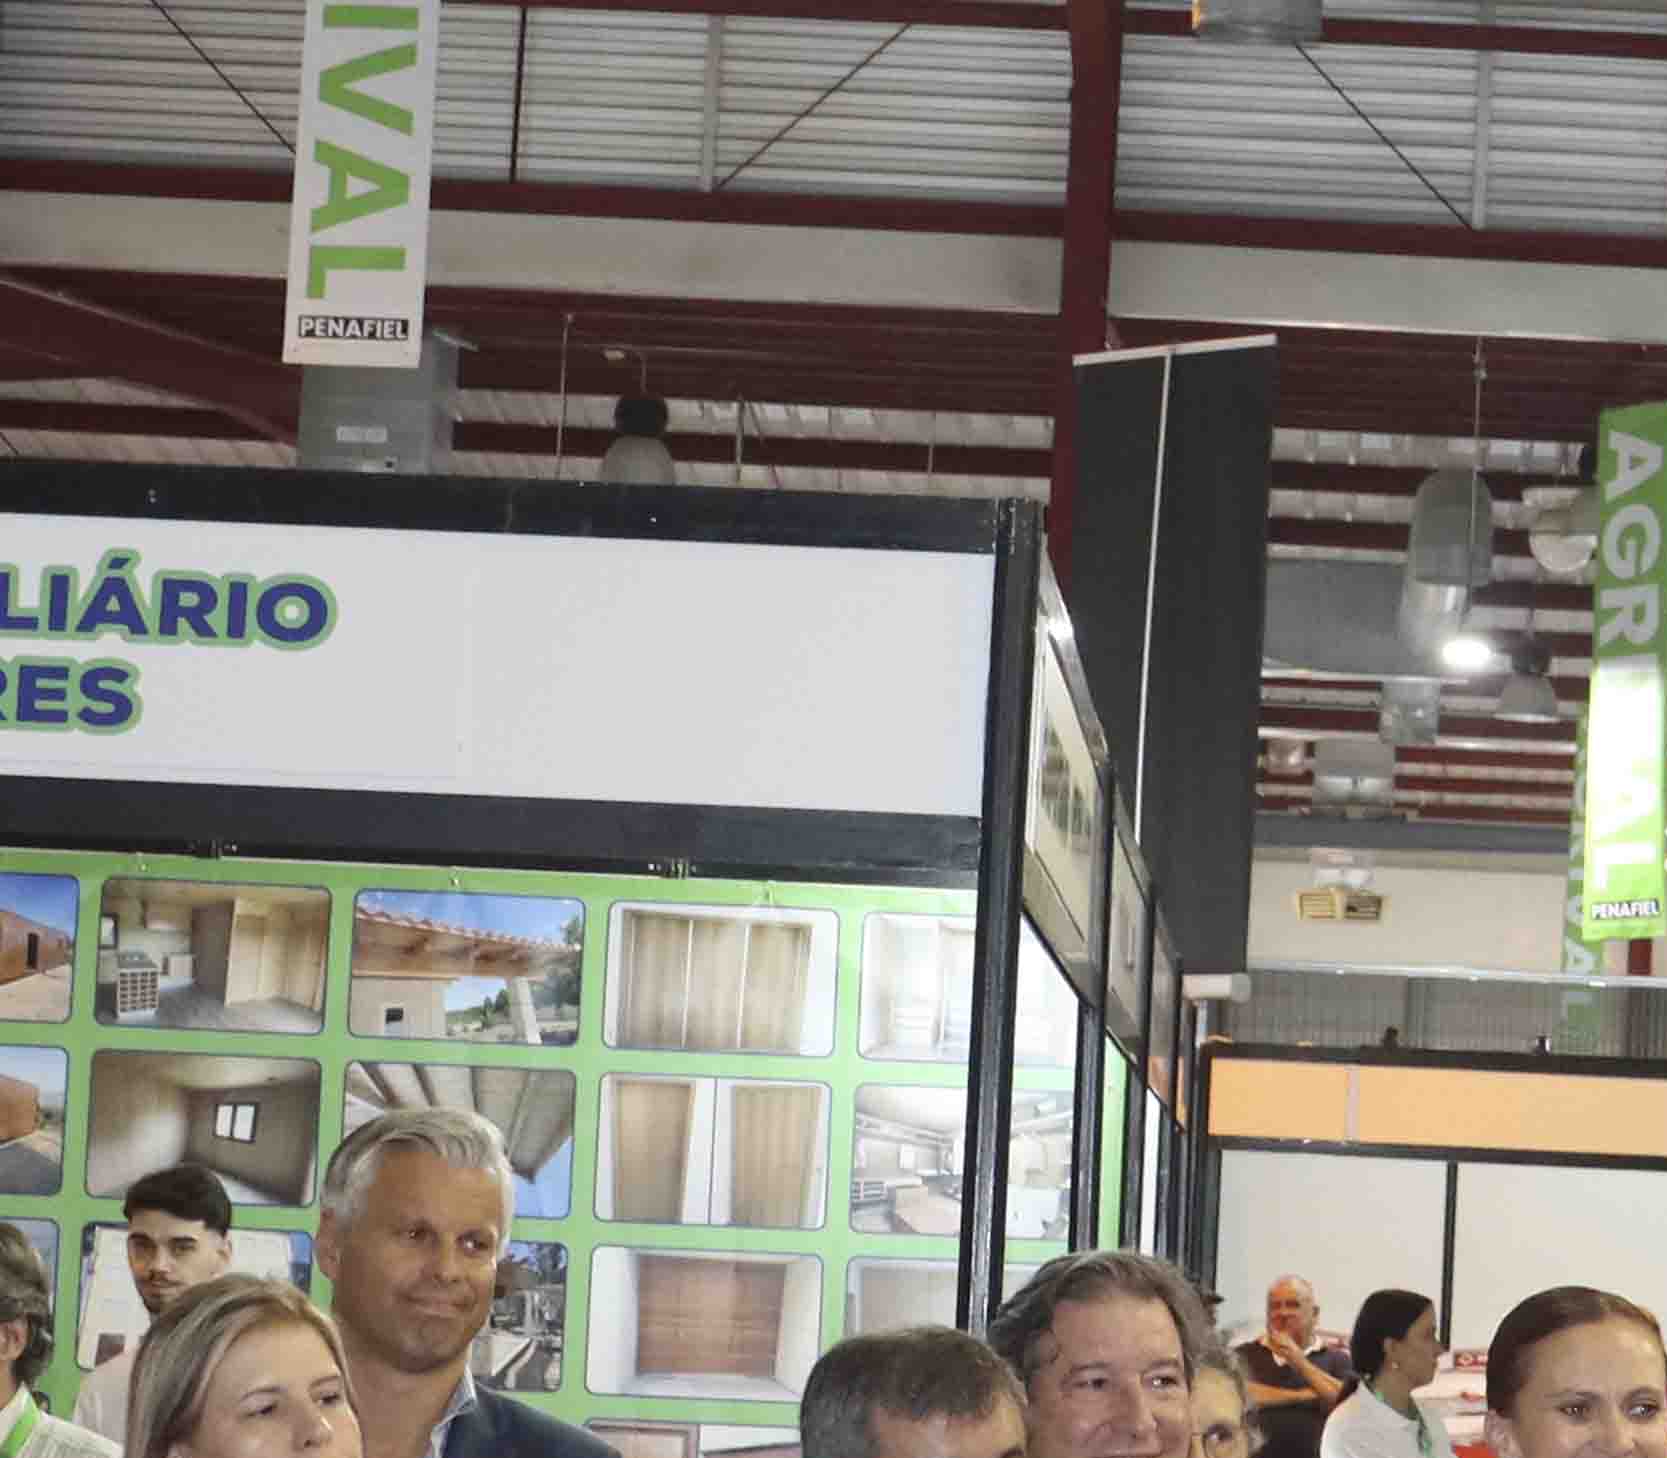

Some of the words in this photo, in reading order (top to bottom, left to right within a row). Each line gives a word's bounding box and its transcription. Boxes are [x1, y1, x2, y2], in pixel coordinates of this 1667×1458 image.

[306, 5, 420, 300] IVAL
[299, 317, 409, 340] PENAFIEL
[0, 556, 328, 643] LIÁRIO
[0, 664, 134, 727] ES
[1597, 430, 1662, 891] AGRIAL
[1591, 900, 1661, 919] PENAFIEL
